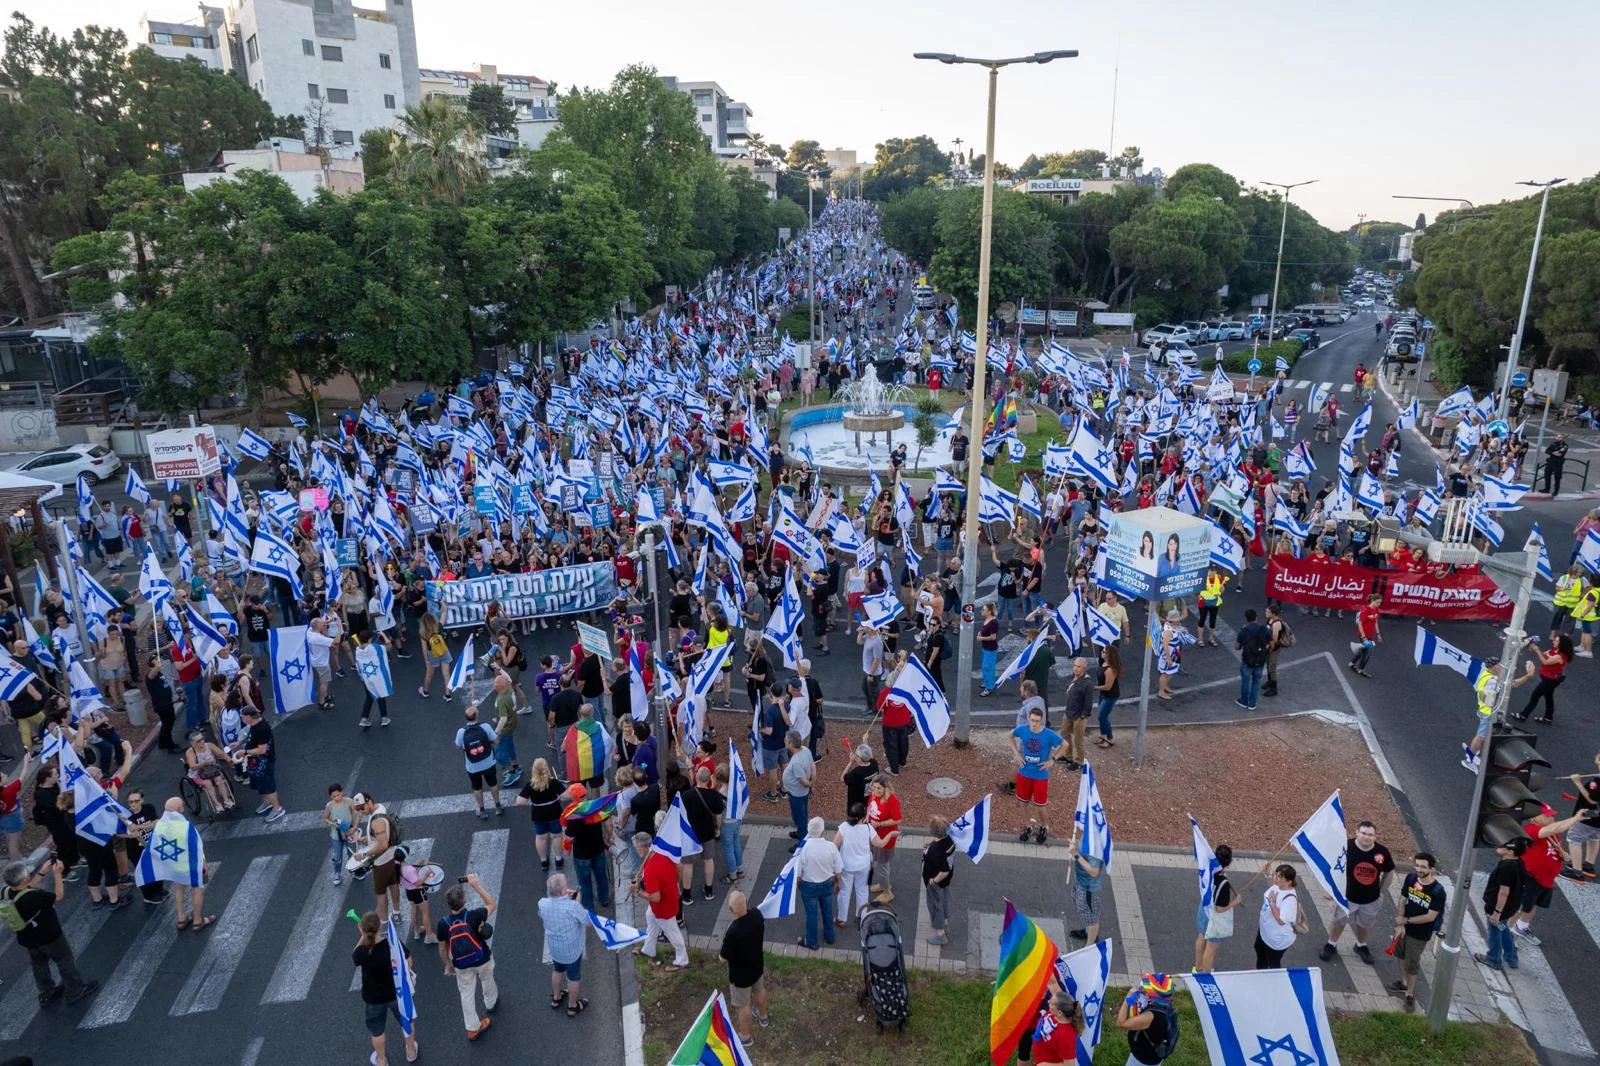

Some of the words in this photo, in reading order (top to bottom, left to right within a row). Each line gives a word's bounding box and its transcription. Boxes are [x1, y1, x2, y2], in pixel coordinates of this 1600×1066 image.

[1031, 181, 1081, 190] ROEILULU
[471, 573, 547, 600] הסבירות
[550, 566, 595, 591] עילת
[1274, 568, 1321, 588] النساء
[1325, 575, 1366, 592] نضال
[444, 582, 467, 602] או
[544, 587, 597, 612] עליית
[1392, 583, 1440, 600] הנשים
[1441, 588, 1481, 601] מאבק
